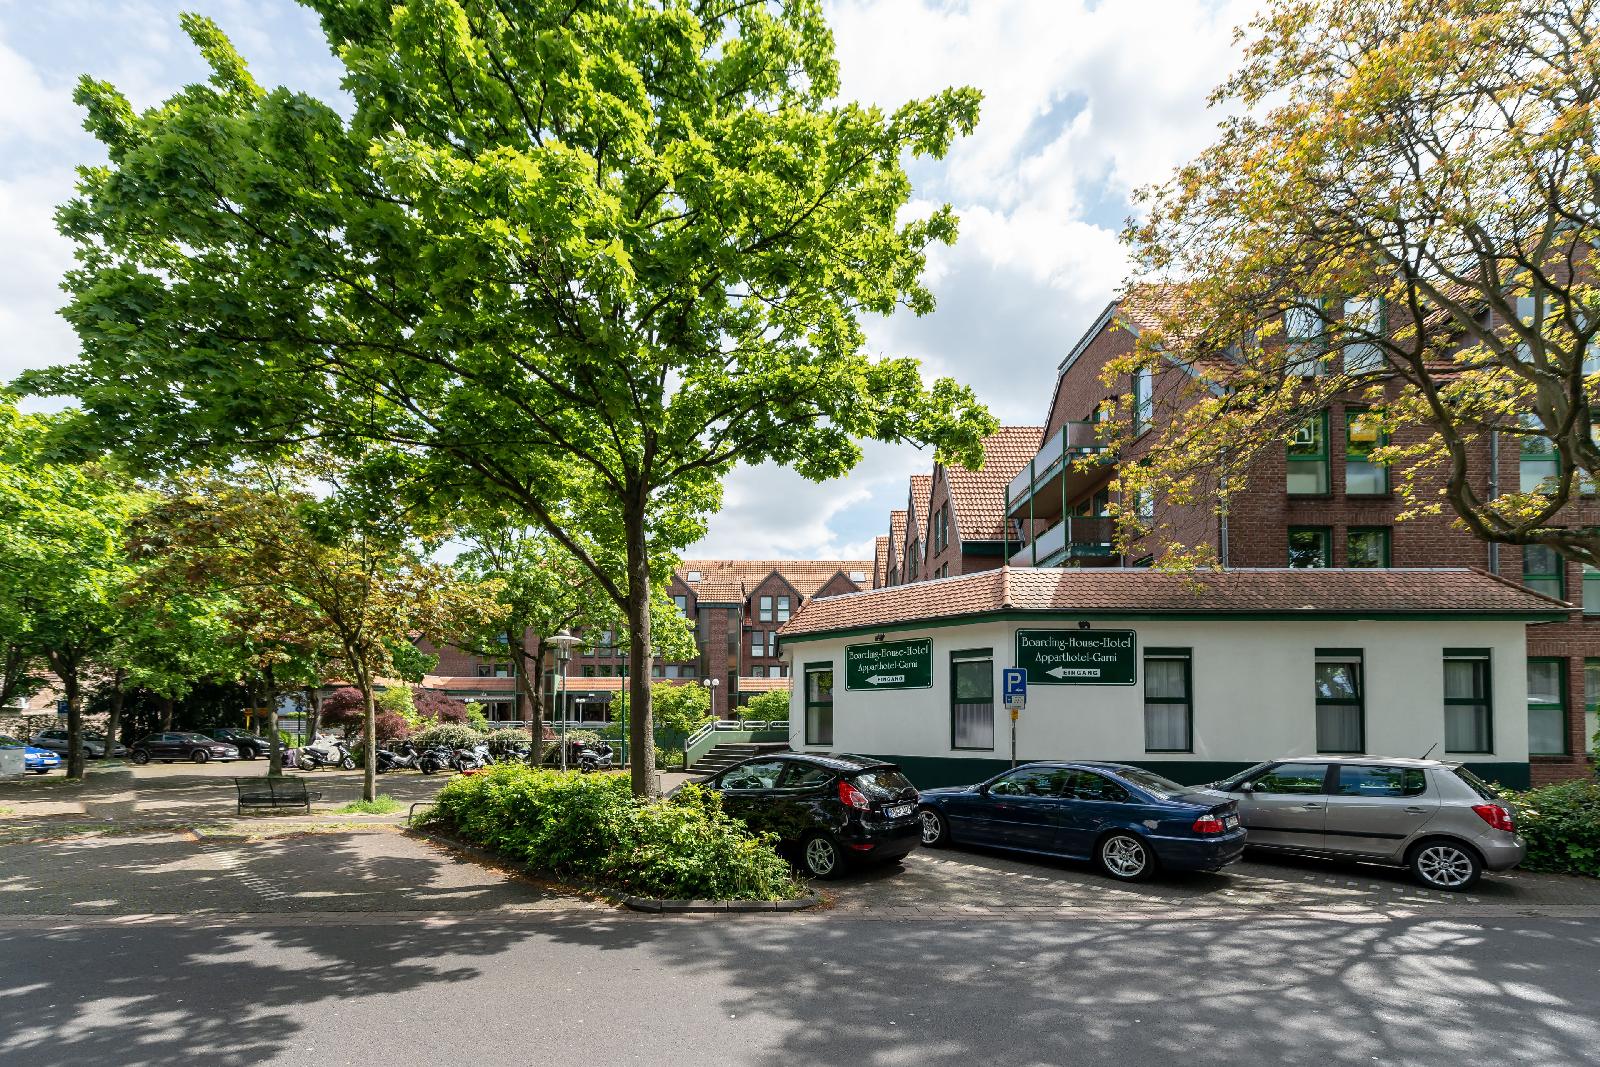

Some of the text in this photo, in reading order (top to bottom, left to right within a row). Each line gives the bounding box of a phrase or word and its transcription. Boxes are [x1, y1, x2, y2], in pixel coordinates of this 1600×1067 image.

[1021, 636, 1131, 650] Boarding-House-Hotel
[848, 644, 929, 661] Boarding-House-Hotel
[1007, 672, 1022, 693] P
